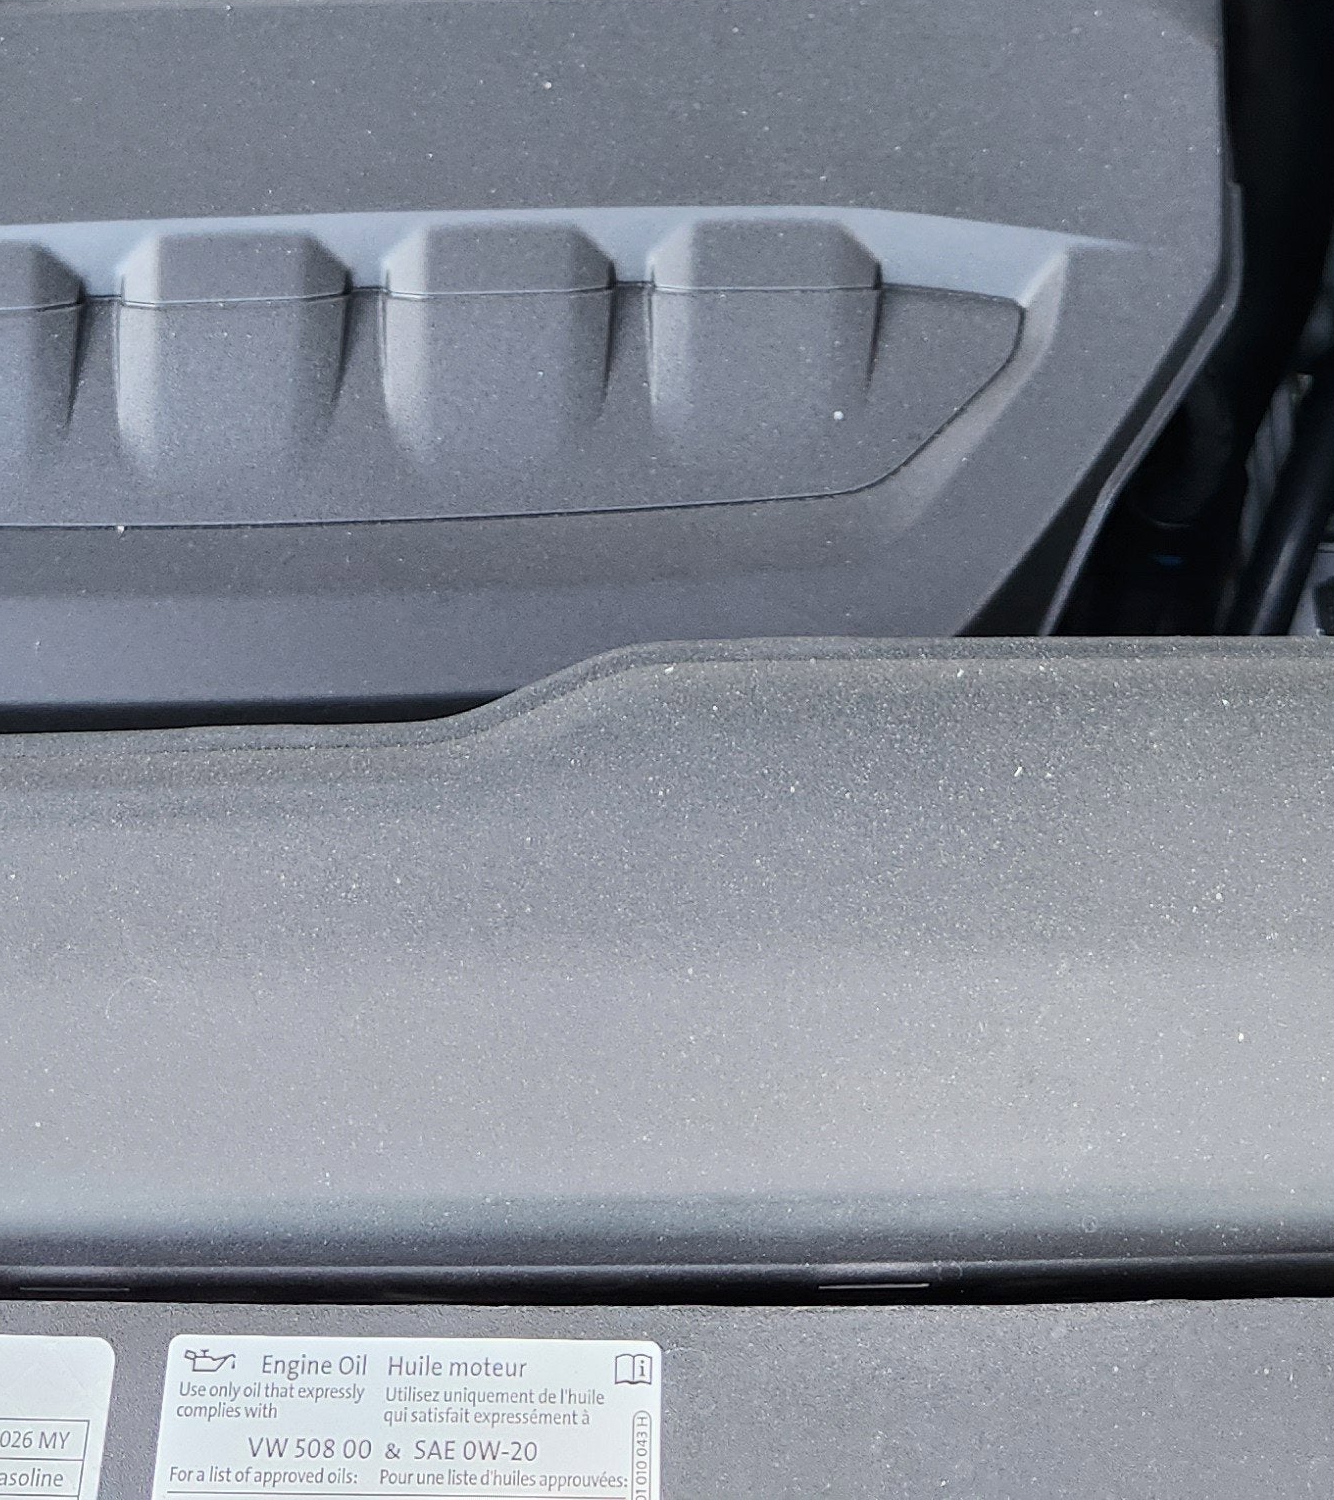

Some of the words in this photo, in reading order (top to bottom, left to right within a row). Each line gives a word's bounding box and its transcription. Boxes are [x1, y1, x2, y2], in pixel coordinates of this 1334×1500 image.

[262, 1355, 332, 1381] Engine
[339, 1354, 367, 1376] Oil
[388, 1355, 442, 1377] Huile
[449, 1357, 527, 1378] moteur
[179, 1382, 206, 1397] Use
[209, 1382, 241, 1401] only
[243, 1383, 261, 1397] oil
[265, 1383, 294, 1398] that
[298, 1384, 365, 1404] expressly
[385, 1386, 439, 1402] Utilisez
[444, 1387, 534, 1407] uniquement
[539, 1388, 556, 1404] de
[560, 1388, 605, 1405] l'huile
[177, 1403, 241, 1421] complies
[244, 1403, 277, 1418] with
[383, 1408, 408, 1426] qui
[411, 1407, 471, 1424] satisfait
[473, 1408, 578, 1428] expressément
[581, 1409, 590, 1425] à
[636, 1416, 647, 1427] H
[38, 1430, 70, 1449] MY
[248, 1437, 289, 1458] VW
[294, 1438, 335, 1458] 508
[343, 1439, 372, 1459] 00
[385, 1442, 400, 1459] &
[414, 1440, 456, 1460] SAE
[463, 1441, 538, 1461] 0W-20
[636, 1431, 647, 1456] 043
[169, 1466, 194, 1482] For
[196, 1470, 205, 1482] a
[209, 1467, 231, 1482] list
[234, 1467, 253, 1483] of
[254, 1468, 324, 1487] approved
[327, 1468, 358, 1484] oils:
[380, 1469, 413, 1485] Pour
[416, 1473, 443, 1485] une
[448, 1470, 477, 1486] liste
[480, 1470, 536, 1487] d'huiles
[539, 1472, 628, 1491] approuvées:
[636, 1461, 647, 1485] 010
